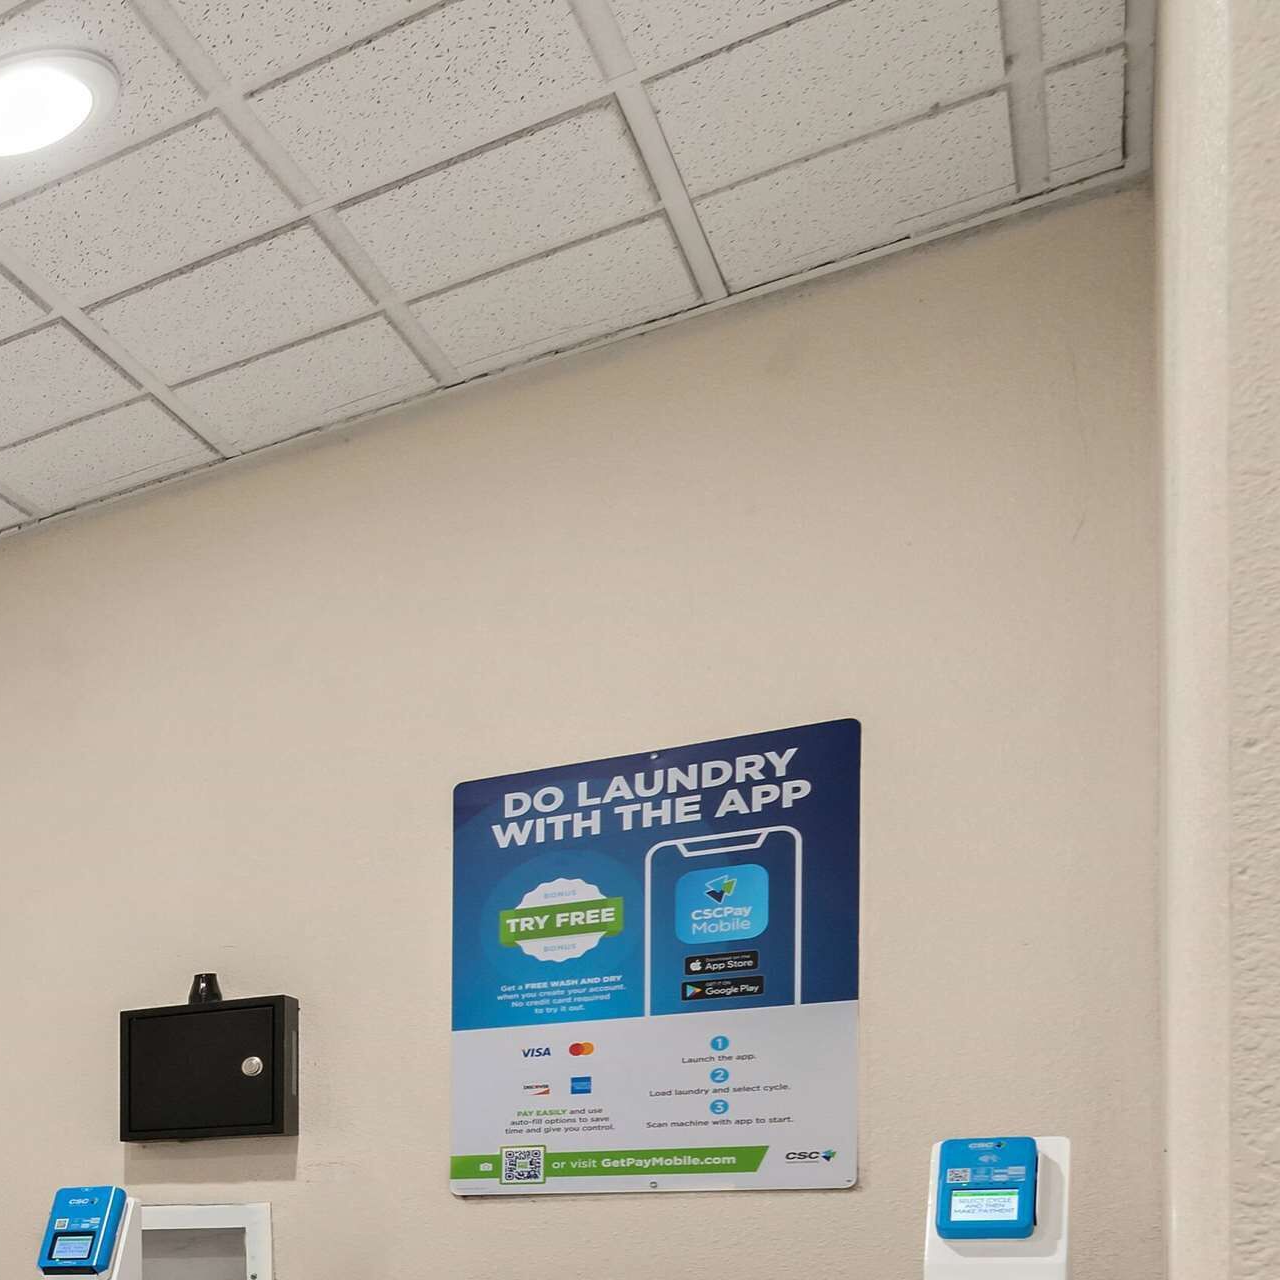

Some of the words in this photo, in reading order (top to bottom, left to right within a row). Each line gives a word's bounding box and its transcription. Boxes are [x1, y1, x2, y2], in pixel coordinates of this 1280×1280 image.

[504, 787, 564, 818] DO
[578, 748, 798, 807] LAUNDRY
[491, 809, 600, 848] WITH
[614, 795, 702, 831] THE
[714, 780, 811, 817] APP
[691, 905, 753, 921] CSCPay
[506, 914, 550, 933] TRY
[556, 907, 615, 928] FREE
[691, 919, 751, 935] Mobile
[705, 962, 725, 971] App
[727, 960, 753, 969] Store
[705, 985, 738, 996] Google
[740, 984, 759, 993] Play
[715, 1038, 723, 1049] 1
[521, 1047, 551, 1058] VISA
[681, 1055, 715, 1064] Launch
[717, 1054, 733, 1062] the
[735, 1053, 756, 1062] app.
[714, 1070, 725, 1081] 2
[649, 1089, 672, 1097] Load
[674, 1087, 709, 1097] laundry
[712, 1086, 729, 1094] and
[732, 1084, 760, 1093] select
[763, 1083, 790, 1092] cycle.
[517, 1109, 534, 1117] PAY
[536, 1108, 567, 1116] EASILY
[569, 1107, 585, 1115] and
[714, 1102, 725, 1112] 3
[510, 1118, 543, 1126] auto-fill
[545, 1117, 576, 1126] options
[646, 1121, 668, 1129] Scan
[670, 1119, 709, 1127] machine
[712, 1118, 732, 1126] with
[734, 1118, 753, 1127] app
[768, 1115, 794, 1124] start.
[505, 1127, 523, 1135] time
[525, 1126, 541, 1134] and
[544, 1125, 562, 1134] give
[564, 1125, 579, 1133] you
[582, 1123, 615, 1132] control.
[785, 1151, 820, 1160] CSC
[551, 1160, 566, 1169] or
[570, 1157, 597, 1169] visit
[601, 1154, 736, 1170] GetPayMobile.com
